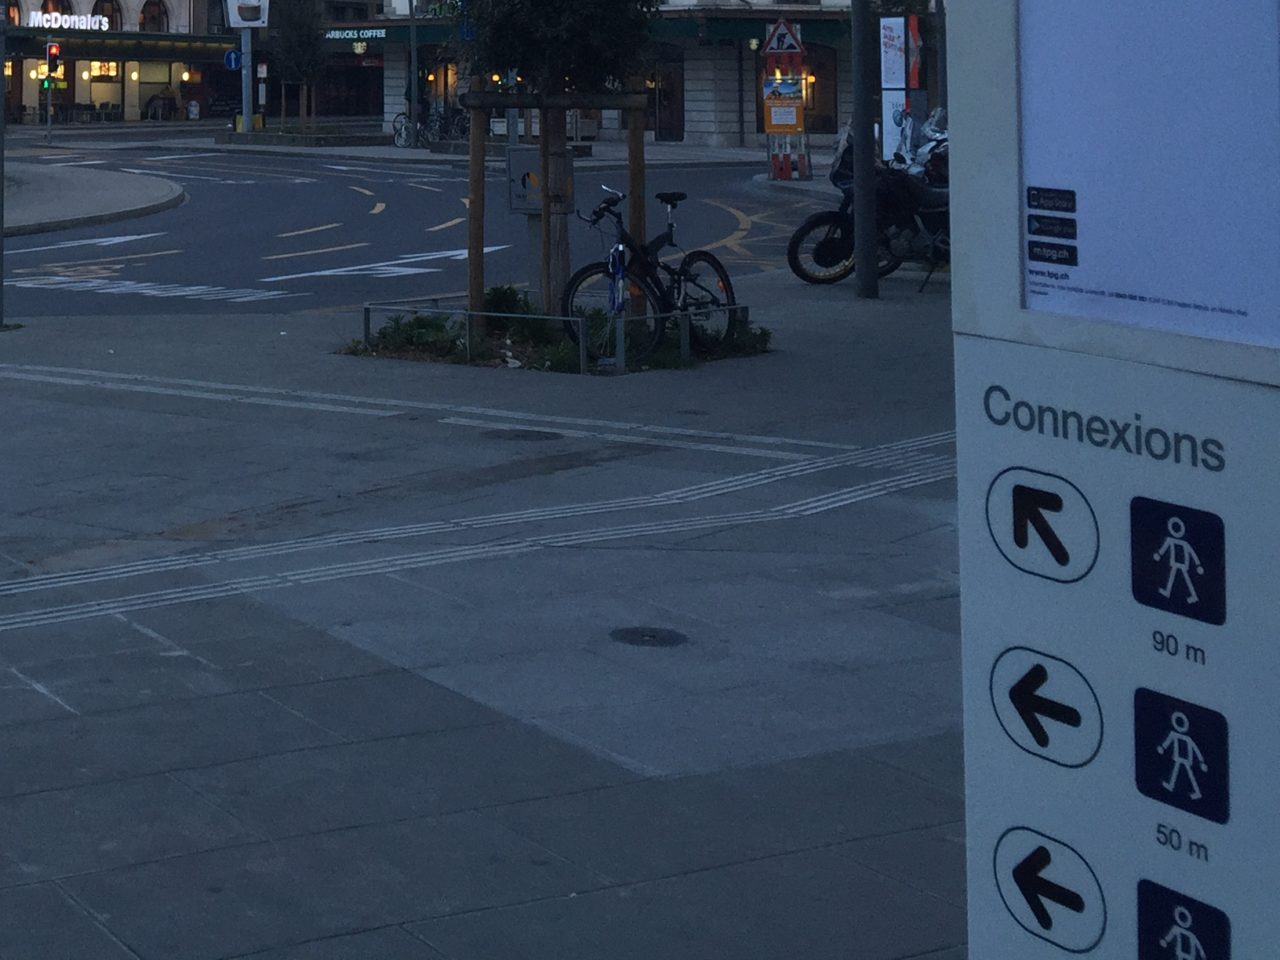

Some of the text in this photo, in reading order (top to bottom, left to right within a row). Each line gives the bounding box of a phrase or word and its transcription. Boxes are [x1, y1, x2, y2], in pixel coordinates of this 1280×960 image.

[29, 11, 110, 31] McDonald's
[324, 29, 387, 39] ARBUCKS COFFEE
[1028, 269, 1070, 280] www.tpg.ch
[983, 384, 1226, 473] Connexions
[1152, 630, 1206, 666] 90 m
[1156, 823, 1209, 863] 50 m
